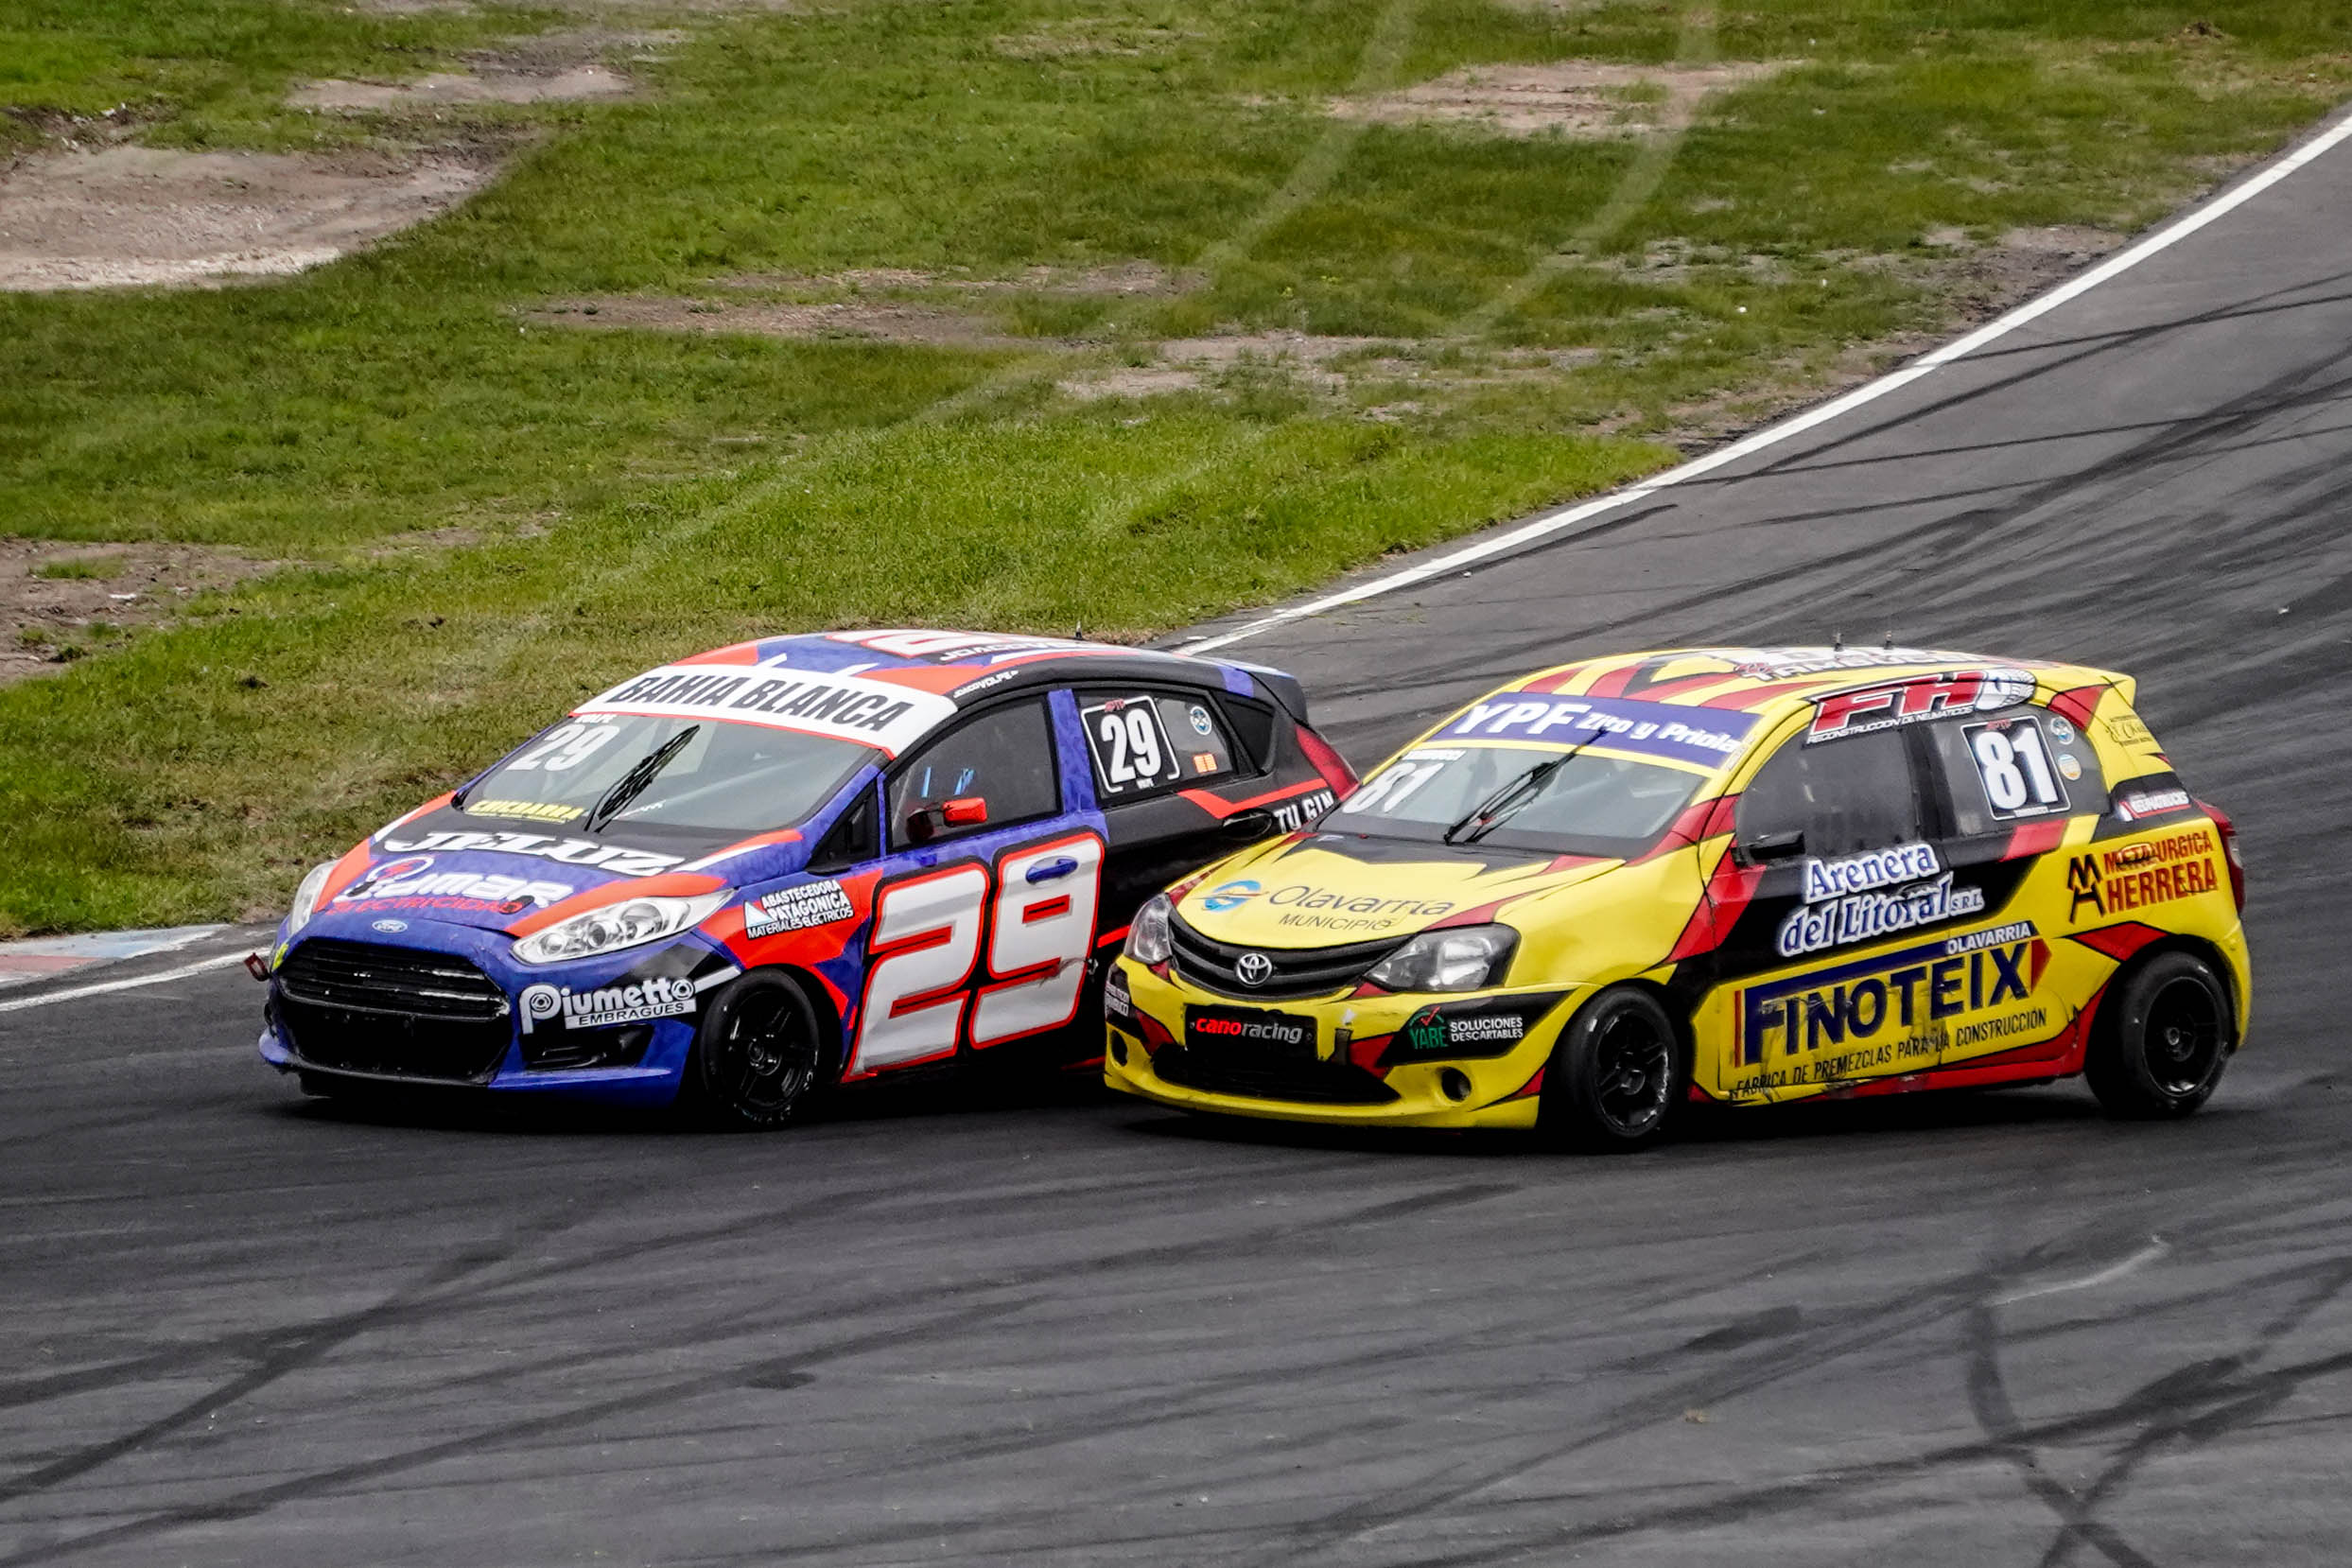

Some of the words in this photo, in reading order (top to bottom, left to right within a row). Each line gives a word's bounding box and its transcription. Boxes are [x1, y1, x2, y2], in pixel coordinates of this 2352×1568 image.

[605, 674, 753, 706] BAHIA
[727, 678, 915, 732] BLANCA
[1454, 702, 1594, 736] YPF
[504, 723, 620, 772] 29
[1100, 707, 1161, 784] 29
[1975, 726, 2059, 810] 81
[1341, 762, 1446, 814] 81
[1273, 803, 1302, 834] TU
[760, 879, 843, 909] ABASTECEDORA
[1806, 845, 1939, 902] Arenera
[2106, 857, 2219, 915] HERRERA
[747, 918, 803, 939] MATERIALES
[1278, 913, 1393, 932] MUNICIPIO
[1782, 904, 1836, 954] del
[1840, 876, 1952, 939] Litoral
[1946, 921, 2031, 956] OLAVARRIA
[843, 832, 1105, 1082] 29
[520, 977, 696, 1035] Piumetto
[578, 1002, 685, 1026] EMBRAGUES
[1449, 1017, 1524, 1033] SOLUCIONES
[1745, 942, 2030, 1066] FINOTEIX
[1408, 1025, 1449, 1050] YABE
[1450, 1028, 1524, 1042] DESCARTABLES
[1793, 1064, 1809, 1084] DE
[1814, 1044, 1892, 1080] PREMEZCLAS
[1897, 1035, 1929, 1060] PARA
